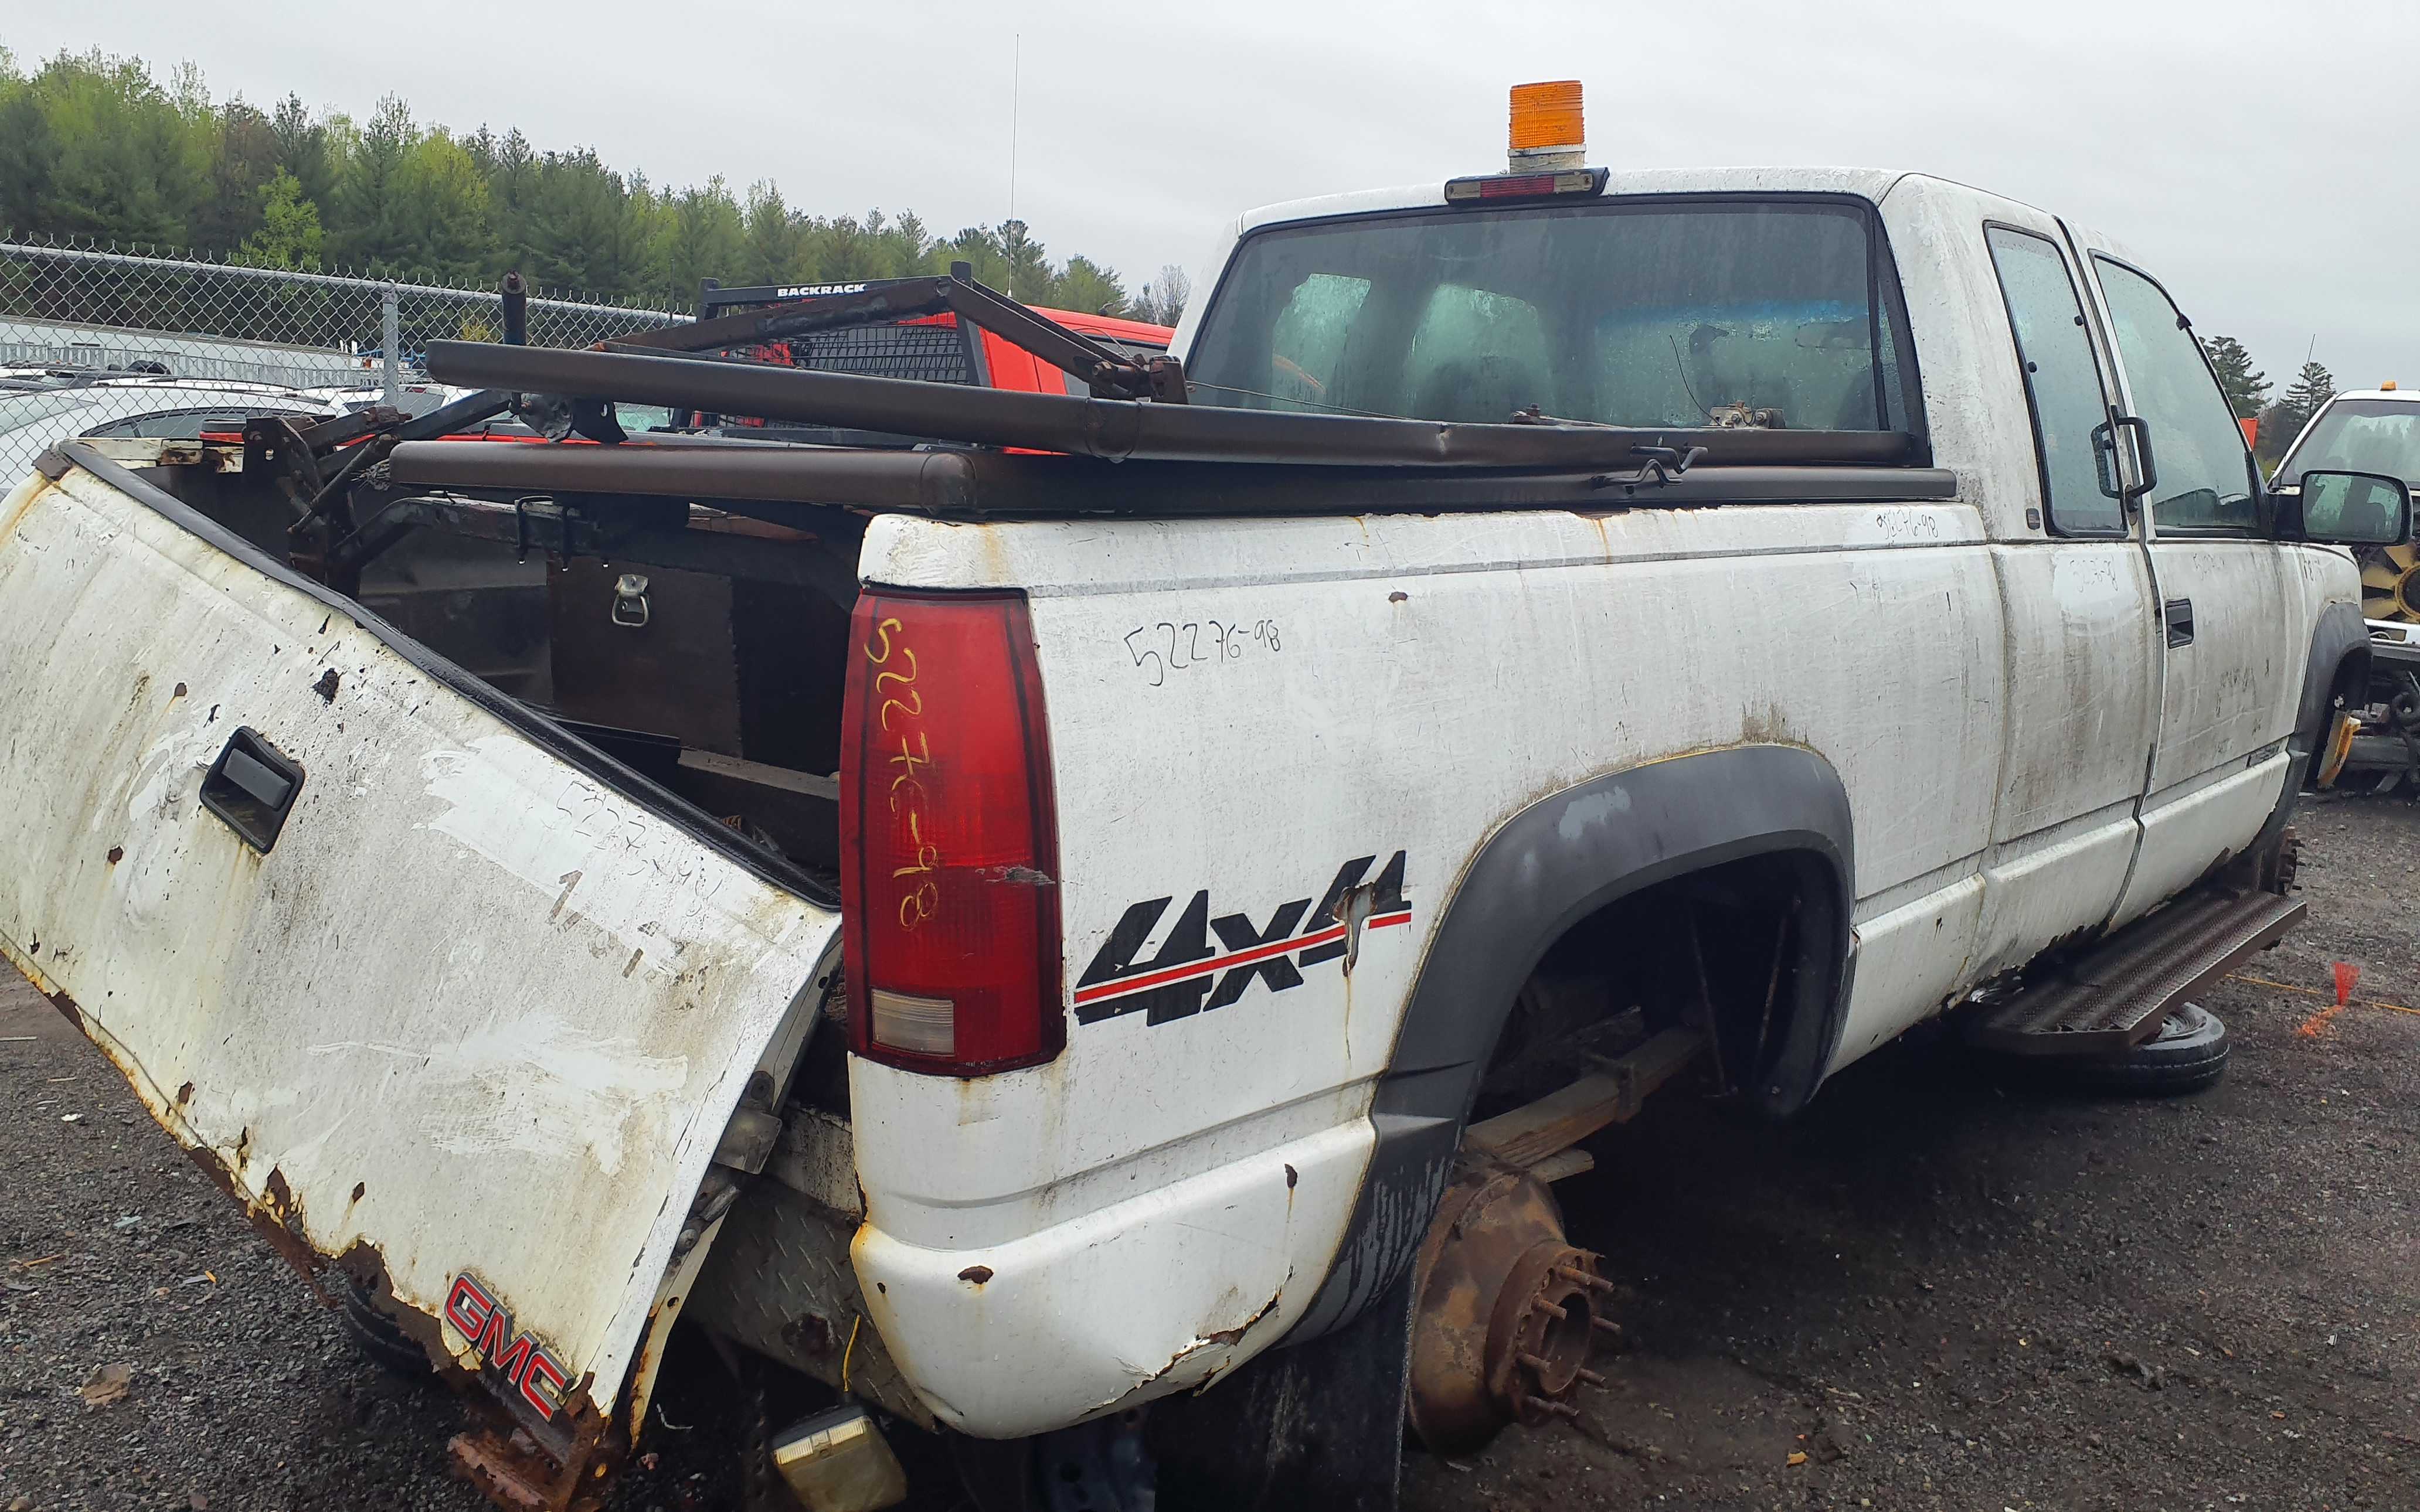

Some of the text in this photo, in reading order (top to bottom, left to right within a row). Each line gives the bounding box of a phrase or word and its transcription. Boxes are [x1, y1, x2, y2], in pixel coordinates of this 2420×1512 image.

[777, 284, 867, 297] BACKRACK
[1124, 620, 1281, 686] 52276-98
[444, 1272, 576, 1423] GMC
